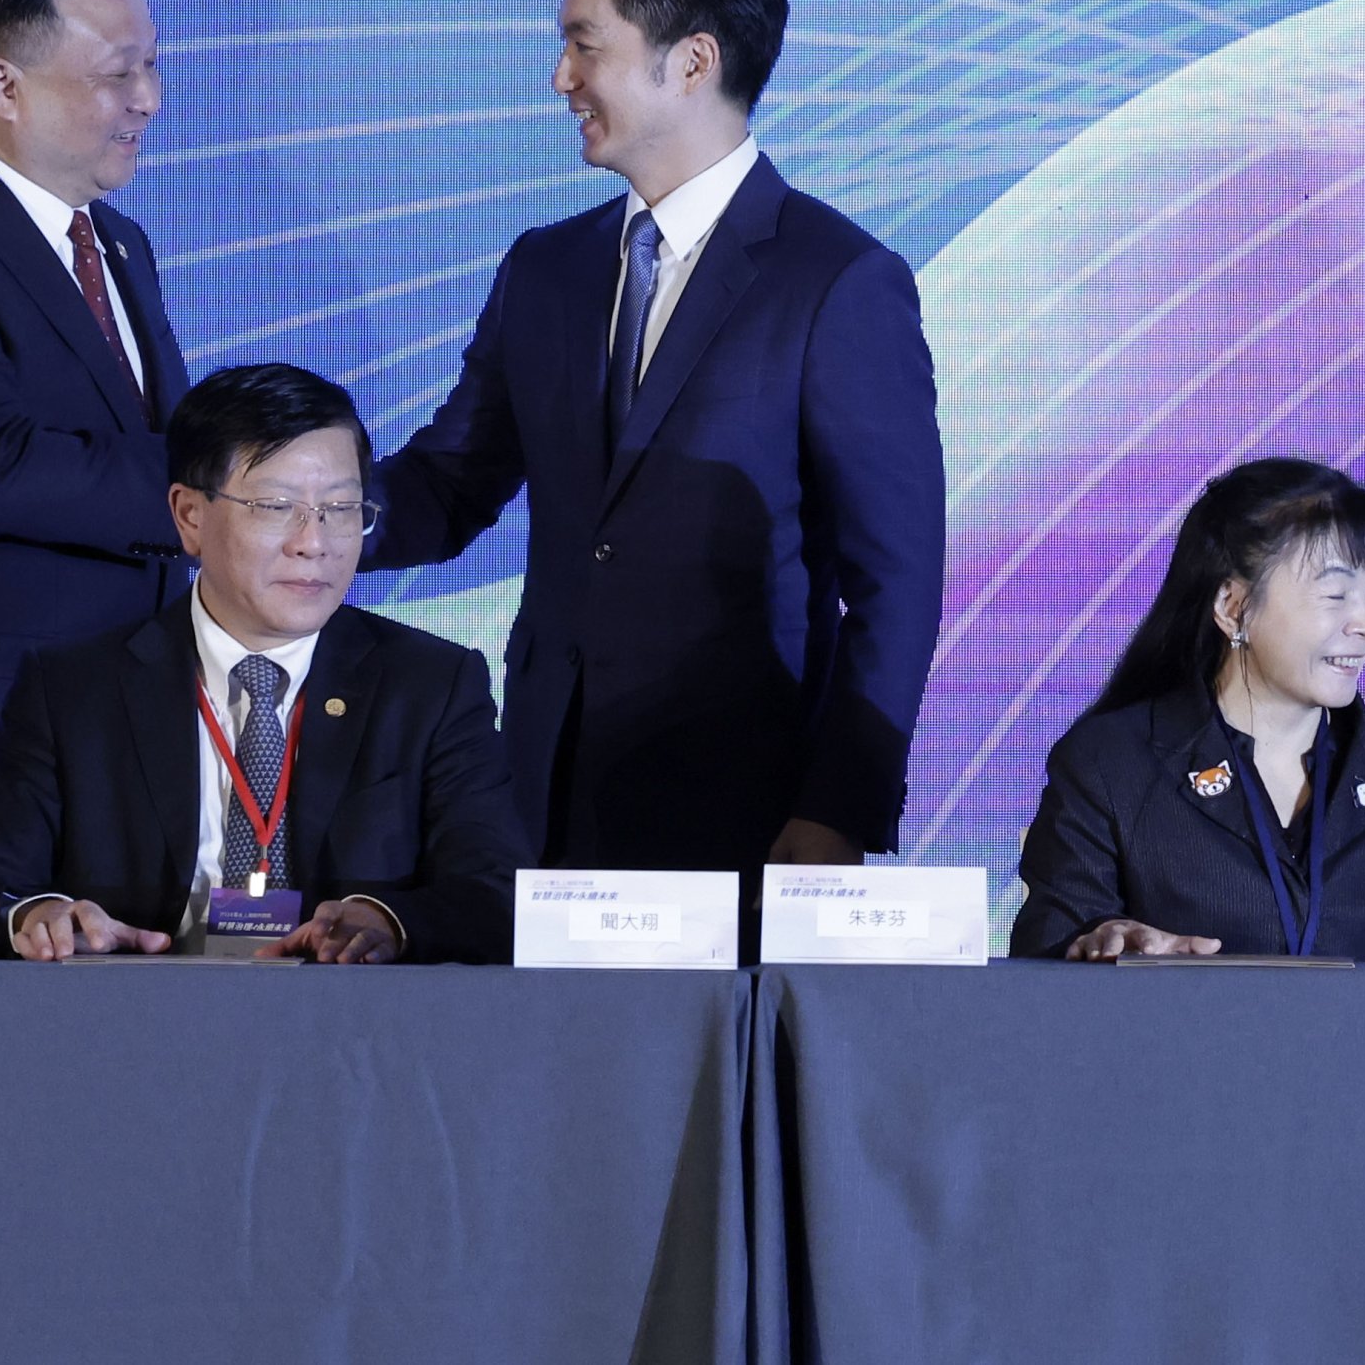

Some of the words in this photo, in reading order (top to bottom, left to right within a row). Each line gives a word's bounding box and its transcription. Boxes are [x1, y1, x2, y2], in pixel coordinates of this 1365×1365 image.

[601, 913, 659, 931] 聞大翔
[848, 909, 907, 927] 朱孝芬
